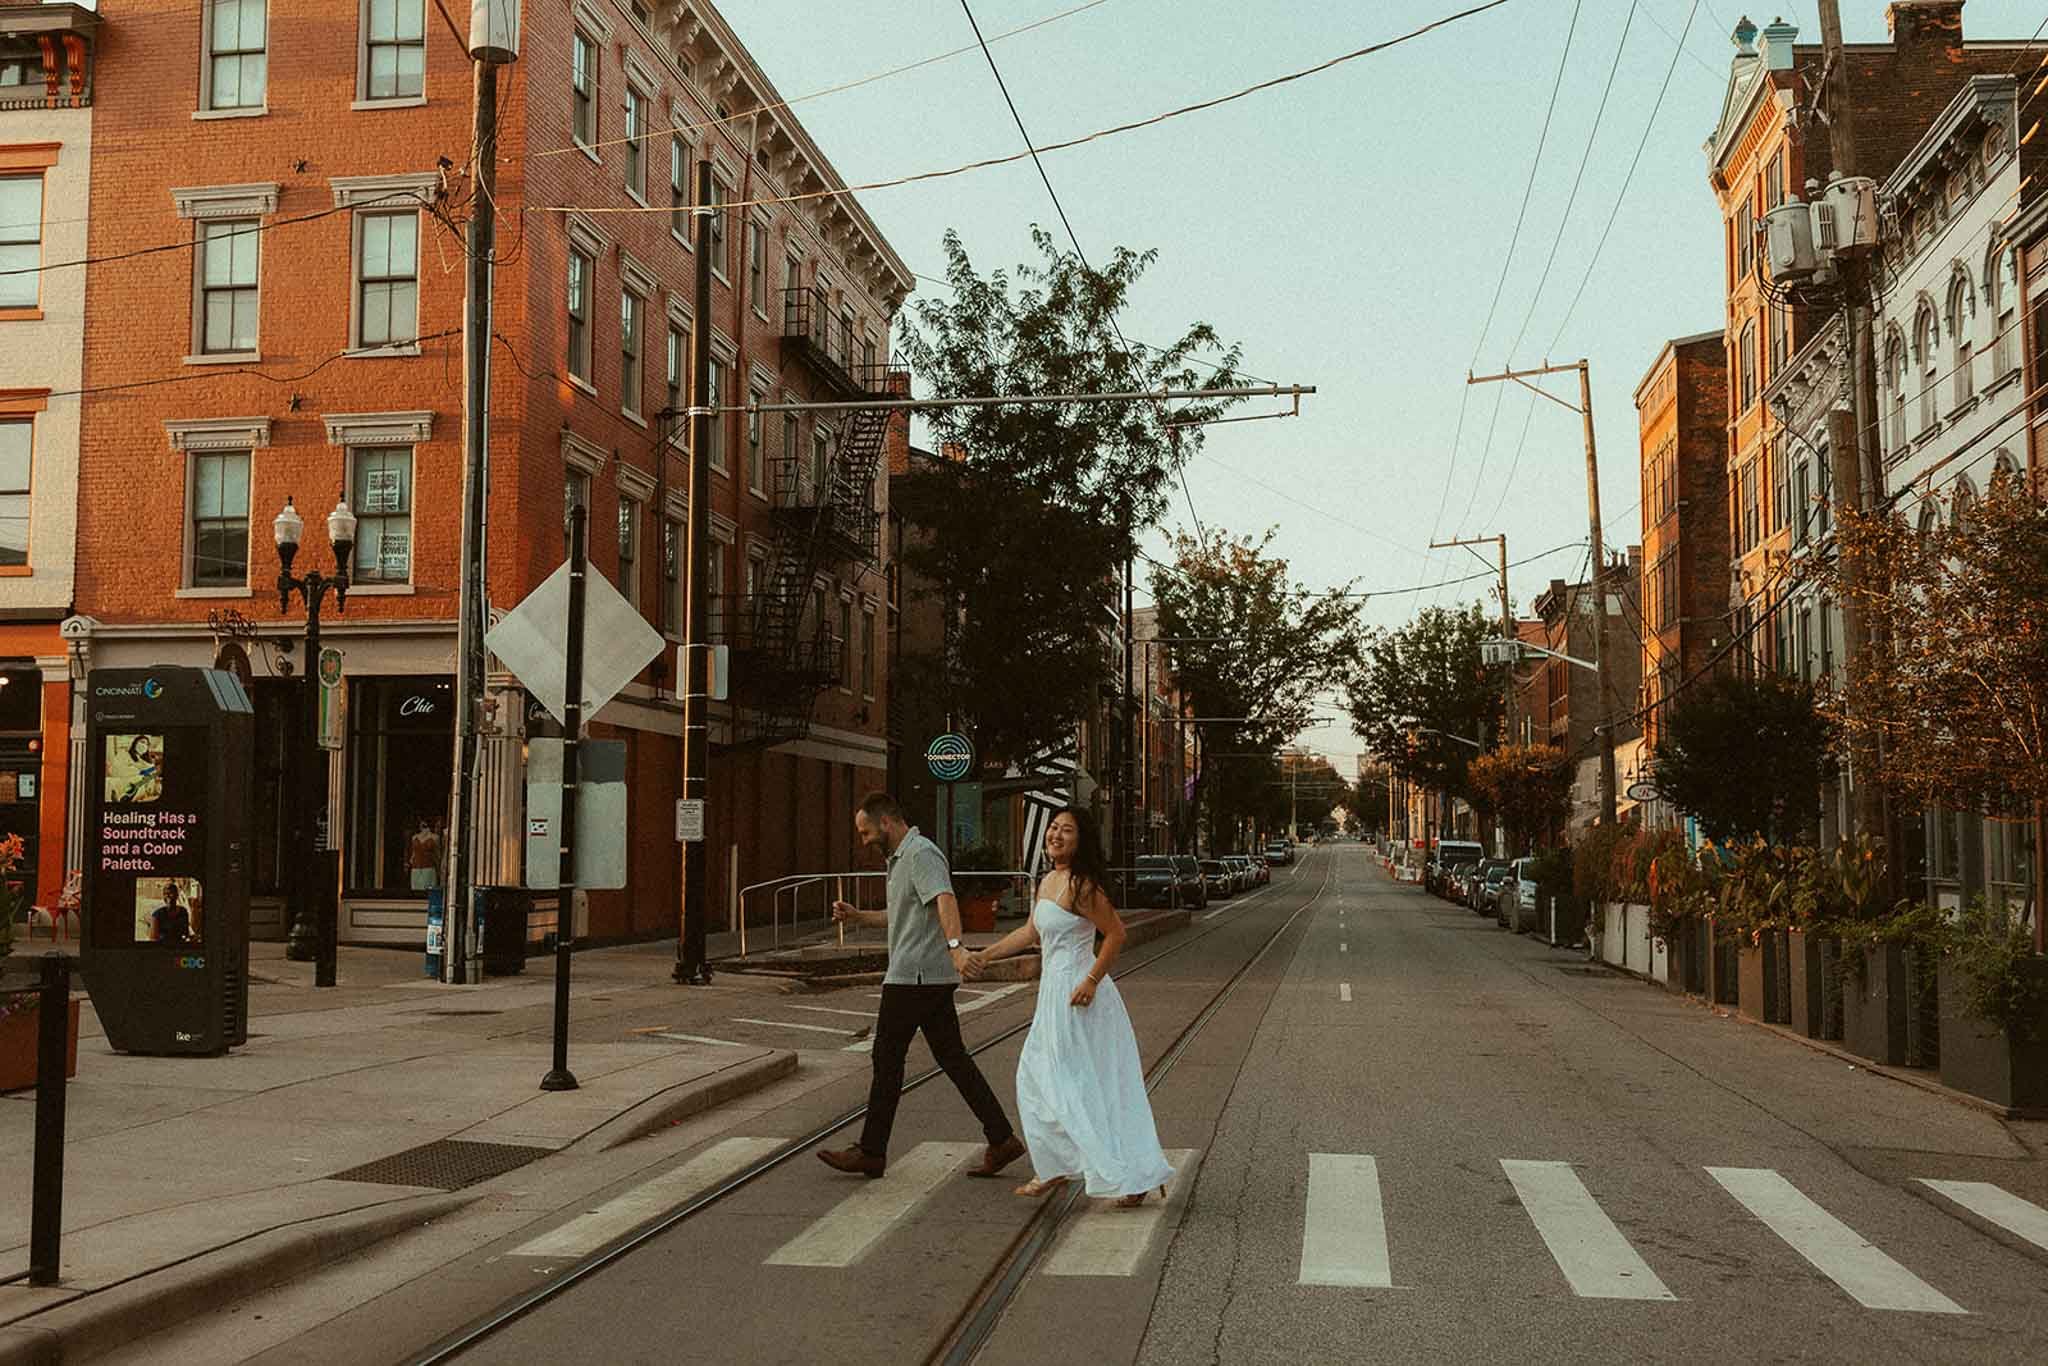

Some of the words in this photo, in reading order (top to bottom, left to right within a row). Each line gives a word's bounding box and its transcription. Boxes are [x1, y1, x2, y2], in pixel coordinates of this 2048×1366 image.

[96, 687, 142, 697] CINCINNATI
[399, 695, 435, 716] Chic
[103, 812, 156, 826] Healing
[158, 812, 185, 824] Has
[187, 815, 197, 824] a
[103, 826, 186, 840] Soundtrack
[102, 843, 129, 855] and
[131, 845, 140, 855] a
[143, 843, 183, 855] Color
[102, 858, 155, 871] Palette.
[176, 1032, 191, 1041] ike
